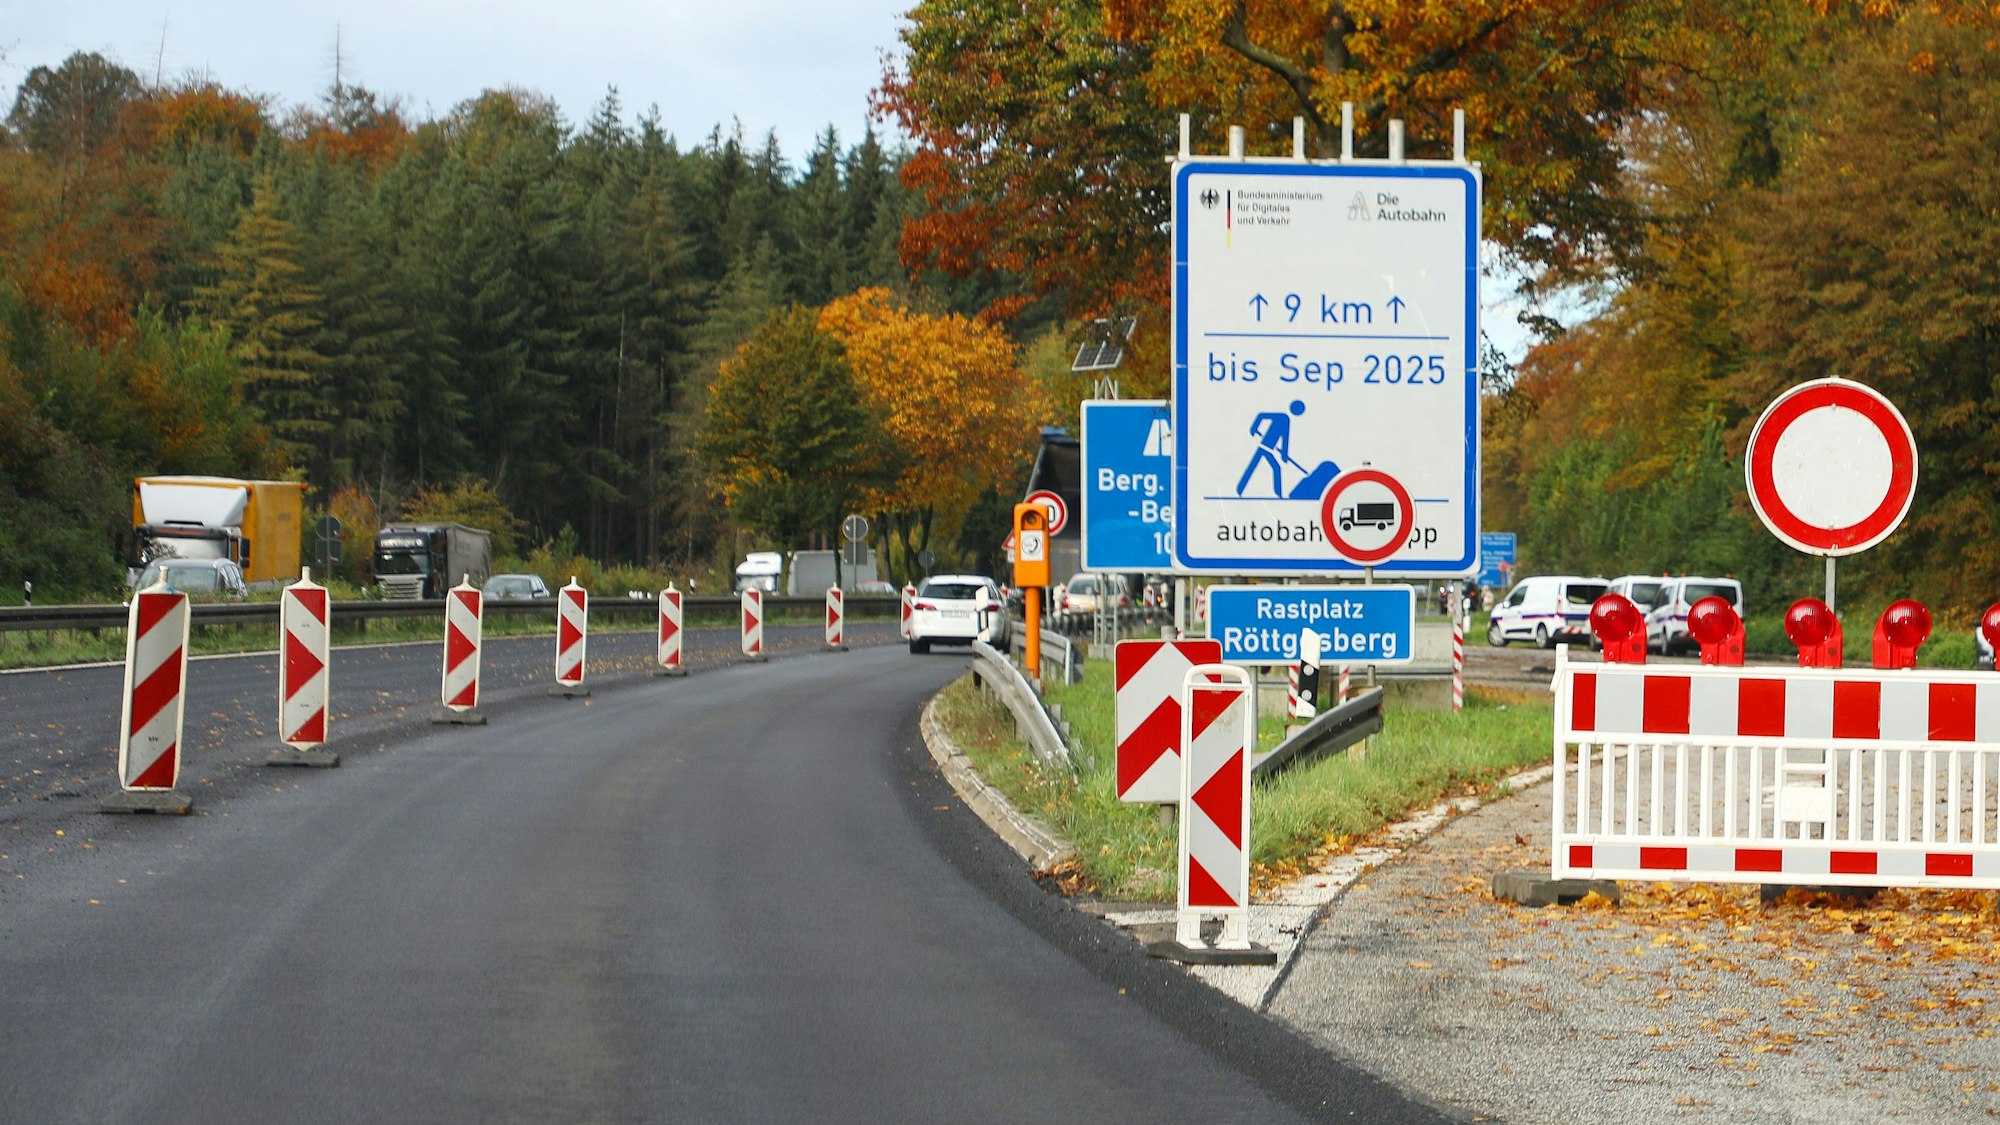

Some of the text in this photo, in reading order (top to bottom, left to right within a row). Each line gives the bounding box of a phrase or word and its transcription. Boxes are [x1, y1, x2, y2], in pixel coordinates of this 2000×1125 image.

[1237, 190, 1323, 201] Bundesministerium
[1377, 193, 1399, 206] Die
[1237, 203, 1290, 214] für Digitales
[1377, 209, 1446, 223] Autobahn
[1237, 216, 1290, 226] und Verkehr
[1284, 293, 1372, 324] 9 km
[1208, 352, 1446, 391] bis Sep 2025
[1098, 468, 1164, 497] Berg.
[1256, 597, 1364, 625] Rastplatz
[1224, 626, 1397, 659] Röttgsberg
